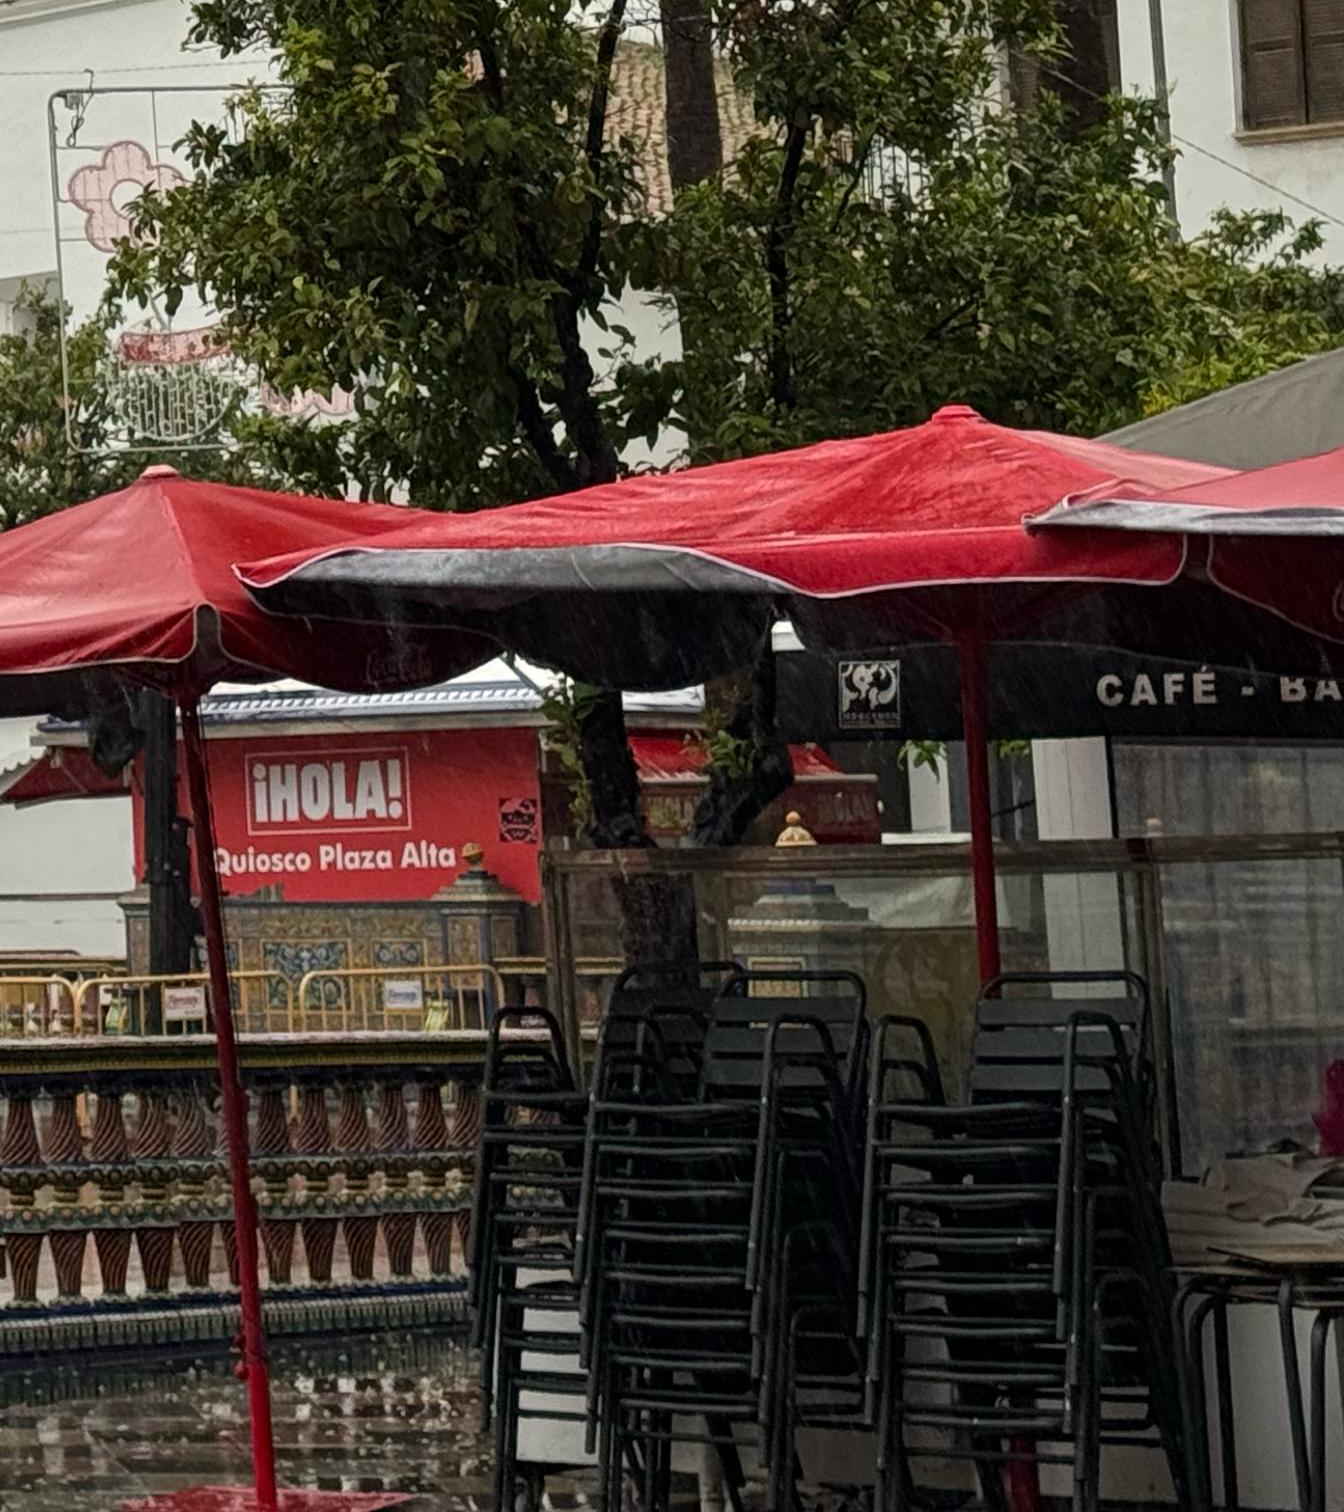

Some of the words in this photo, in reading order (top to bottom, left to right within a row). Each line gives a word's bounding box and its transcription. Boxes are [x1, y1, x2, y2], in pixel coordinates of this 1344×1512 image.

[1096, 664, 1218, 707] CAFÉ
[252, 759, 403, 823] ¡HOLA!
[214, 846, 310, 876] Quiosco
[319, 842, 392, 870] Plaza
[401, 839, 456, 868] Alta
